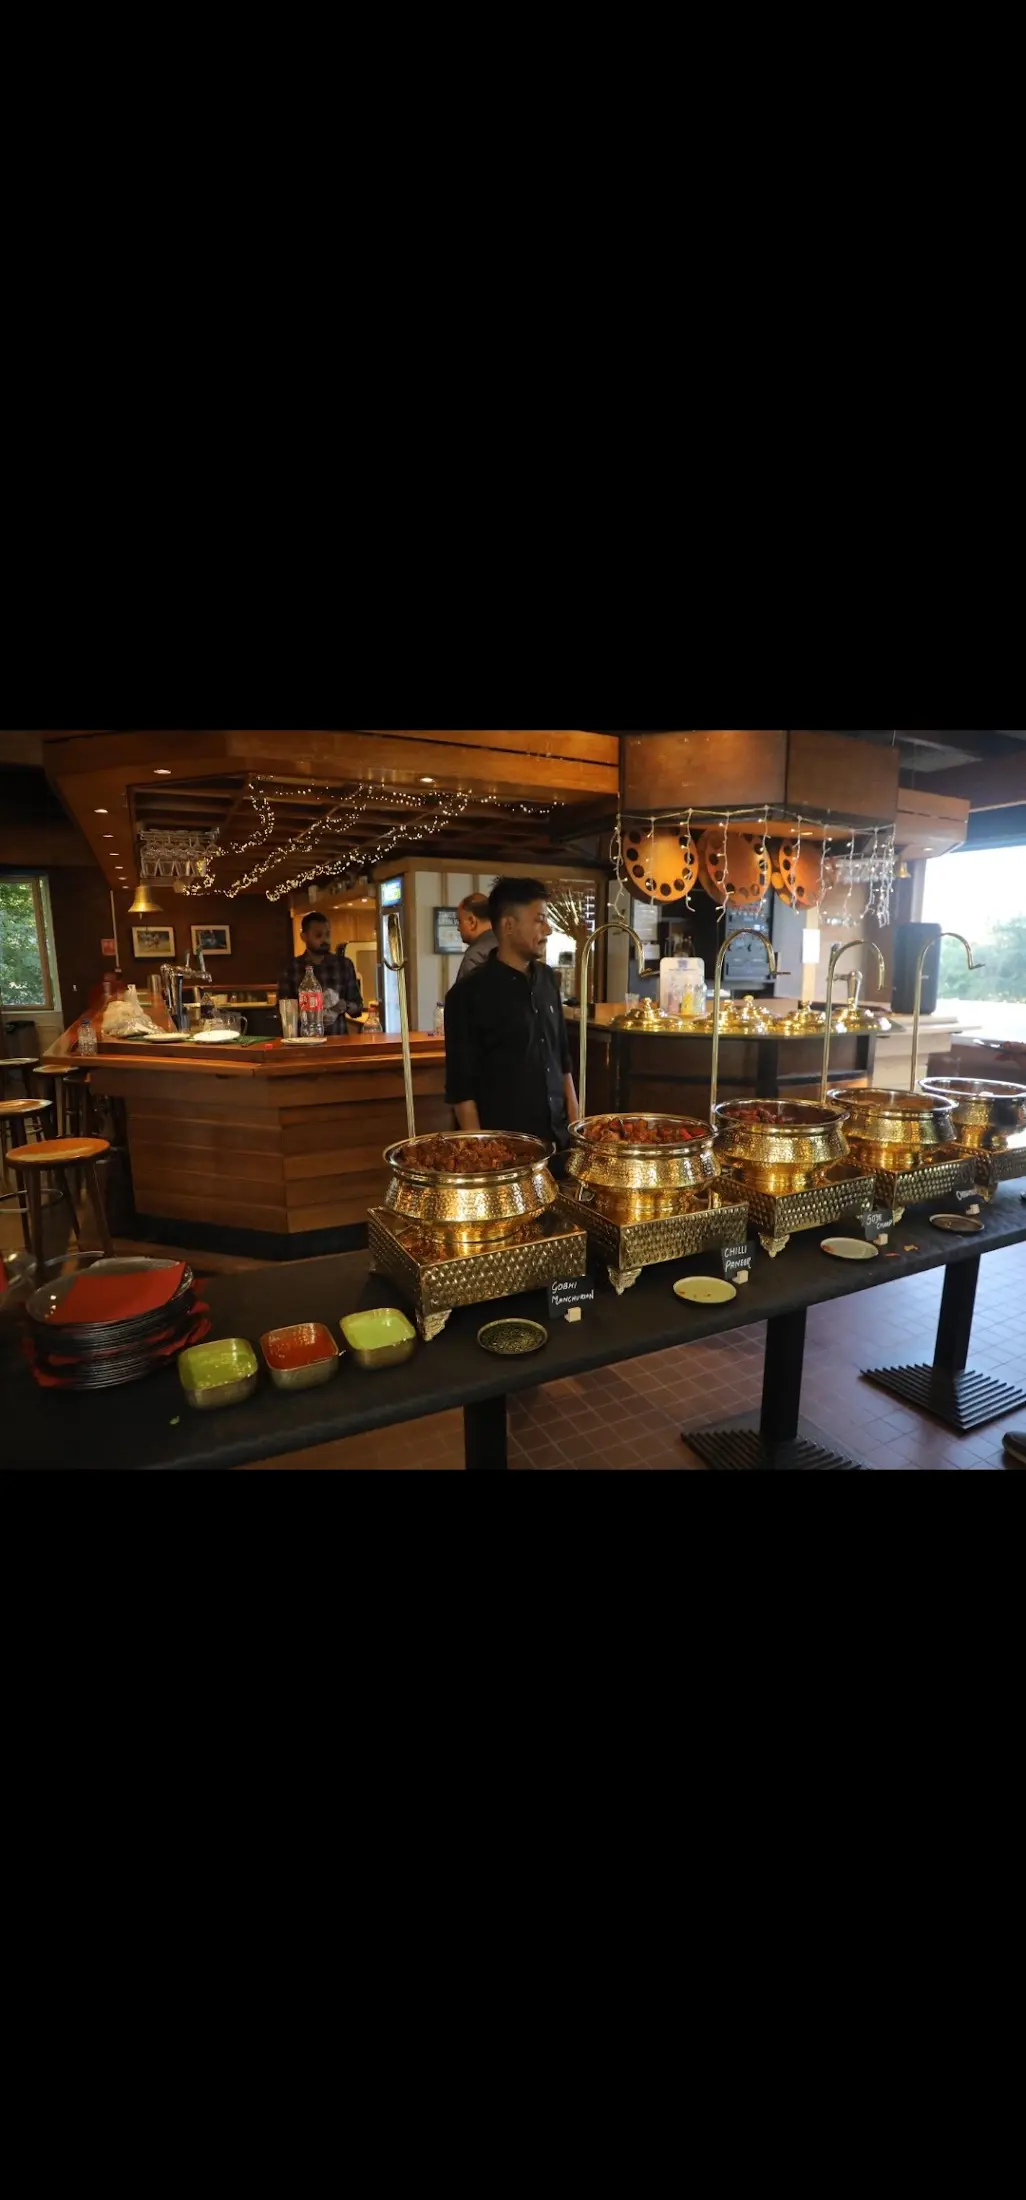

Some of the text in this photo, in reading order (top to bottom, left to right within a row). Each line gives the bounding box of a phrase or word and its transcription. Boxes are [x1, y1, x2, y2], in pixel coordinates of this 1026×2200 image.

[724, 1245, 748, 1258] CHILLI
[724, 1256, 752, 1272] PANEER
[551, 1281, 578, 1294] GOBHI
